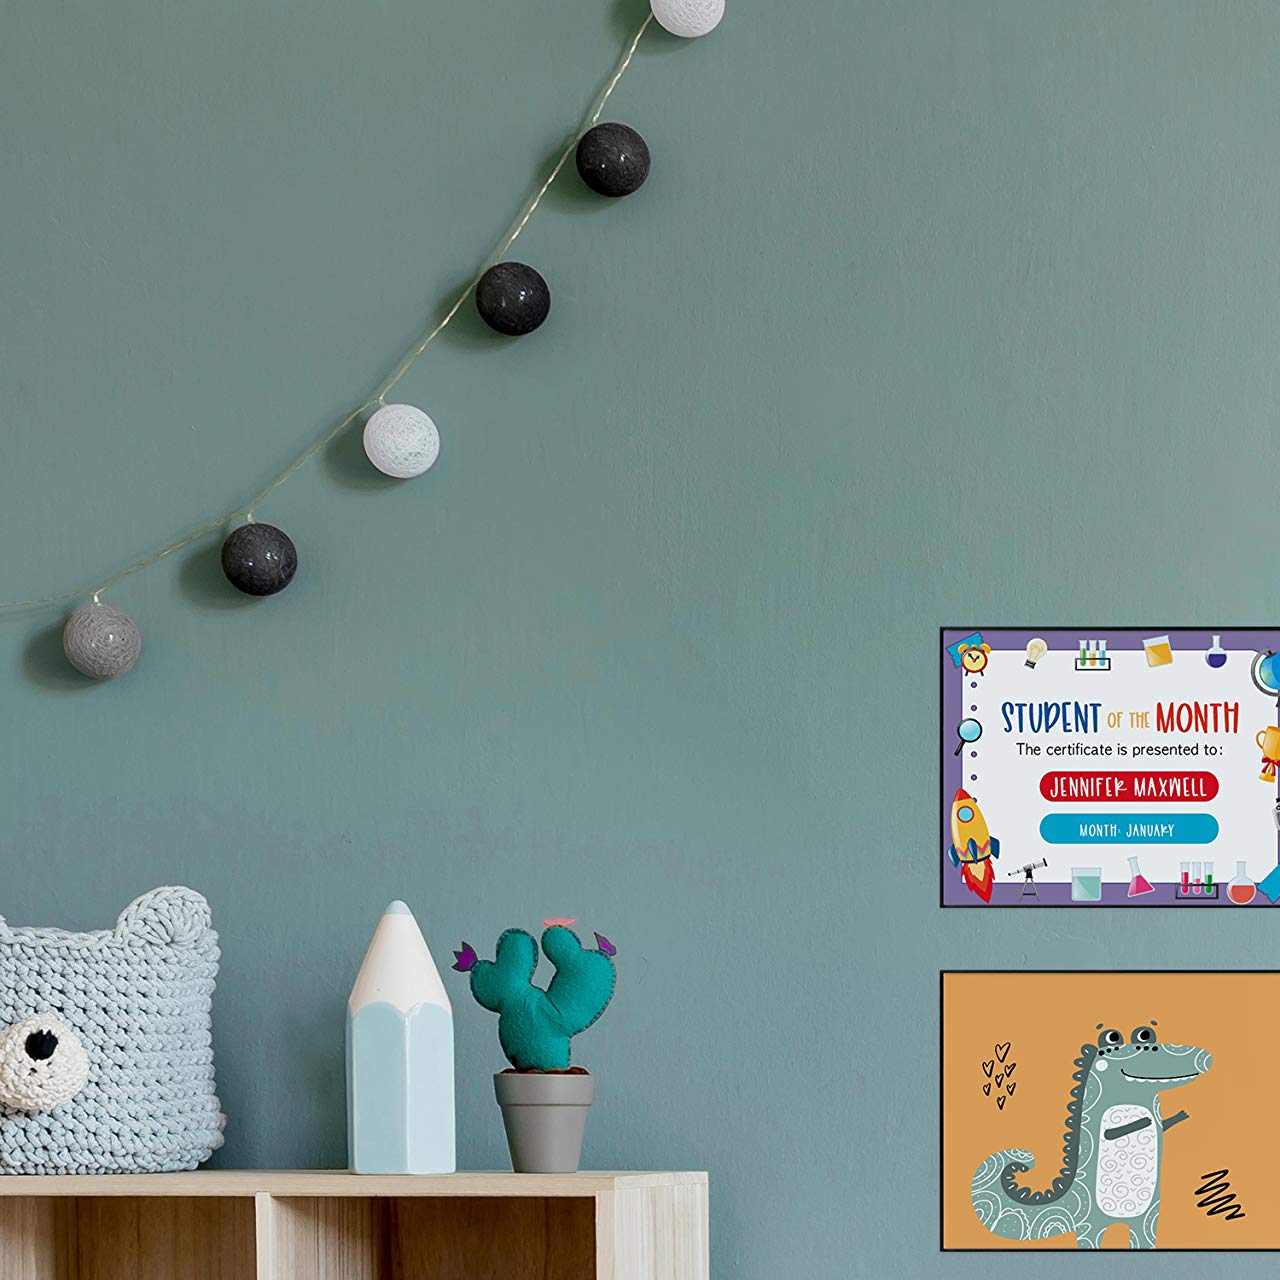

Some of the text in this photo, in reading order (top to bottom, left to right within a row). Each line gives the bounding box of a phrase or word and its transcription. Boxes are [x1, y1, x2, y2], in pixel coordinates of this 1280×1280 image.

[1001, 701, 1239, 733] STUDENT OF THE MONTH
[1016, 742, 1223, 758] The certificate is presented to:
[1050, 777, 1207, 798] JENNIFER MAXWELL
[1126, 823, 1175, 838] JANUARY
